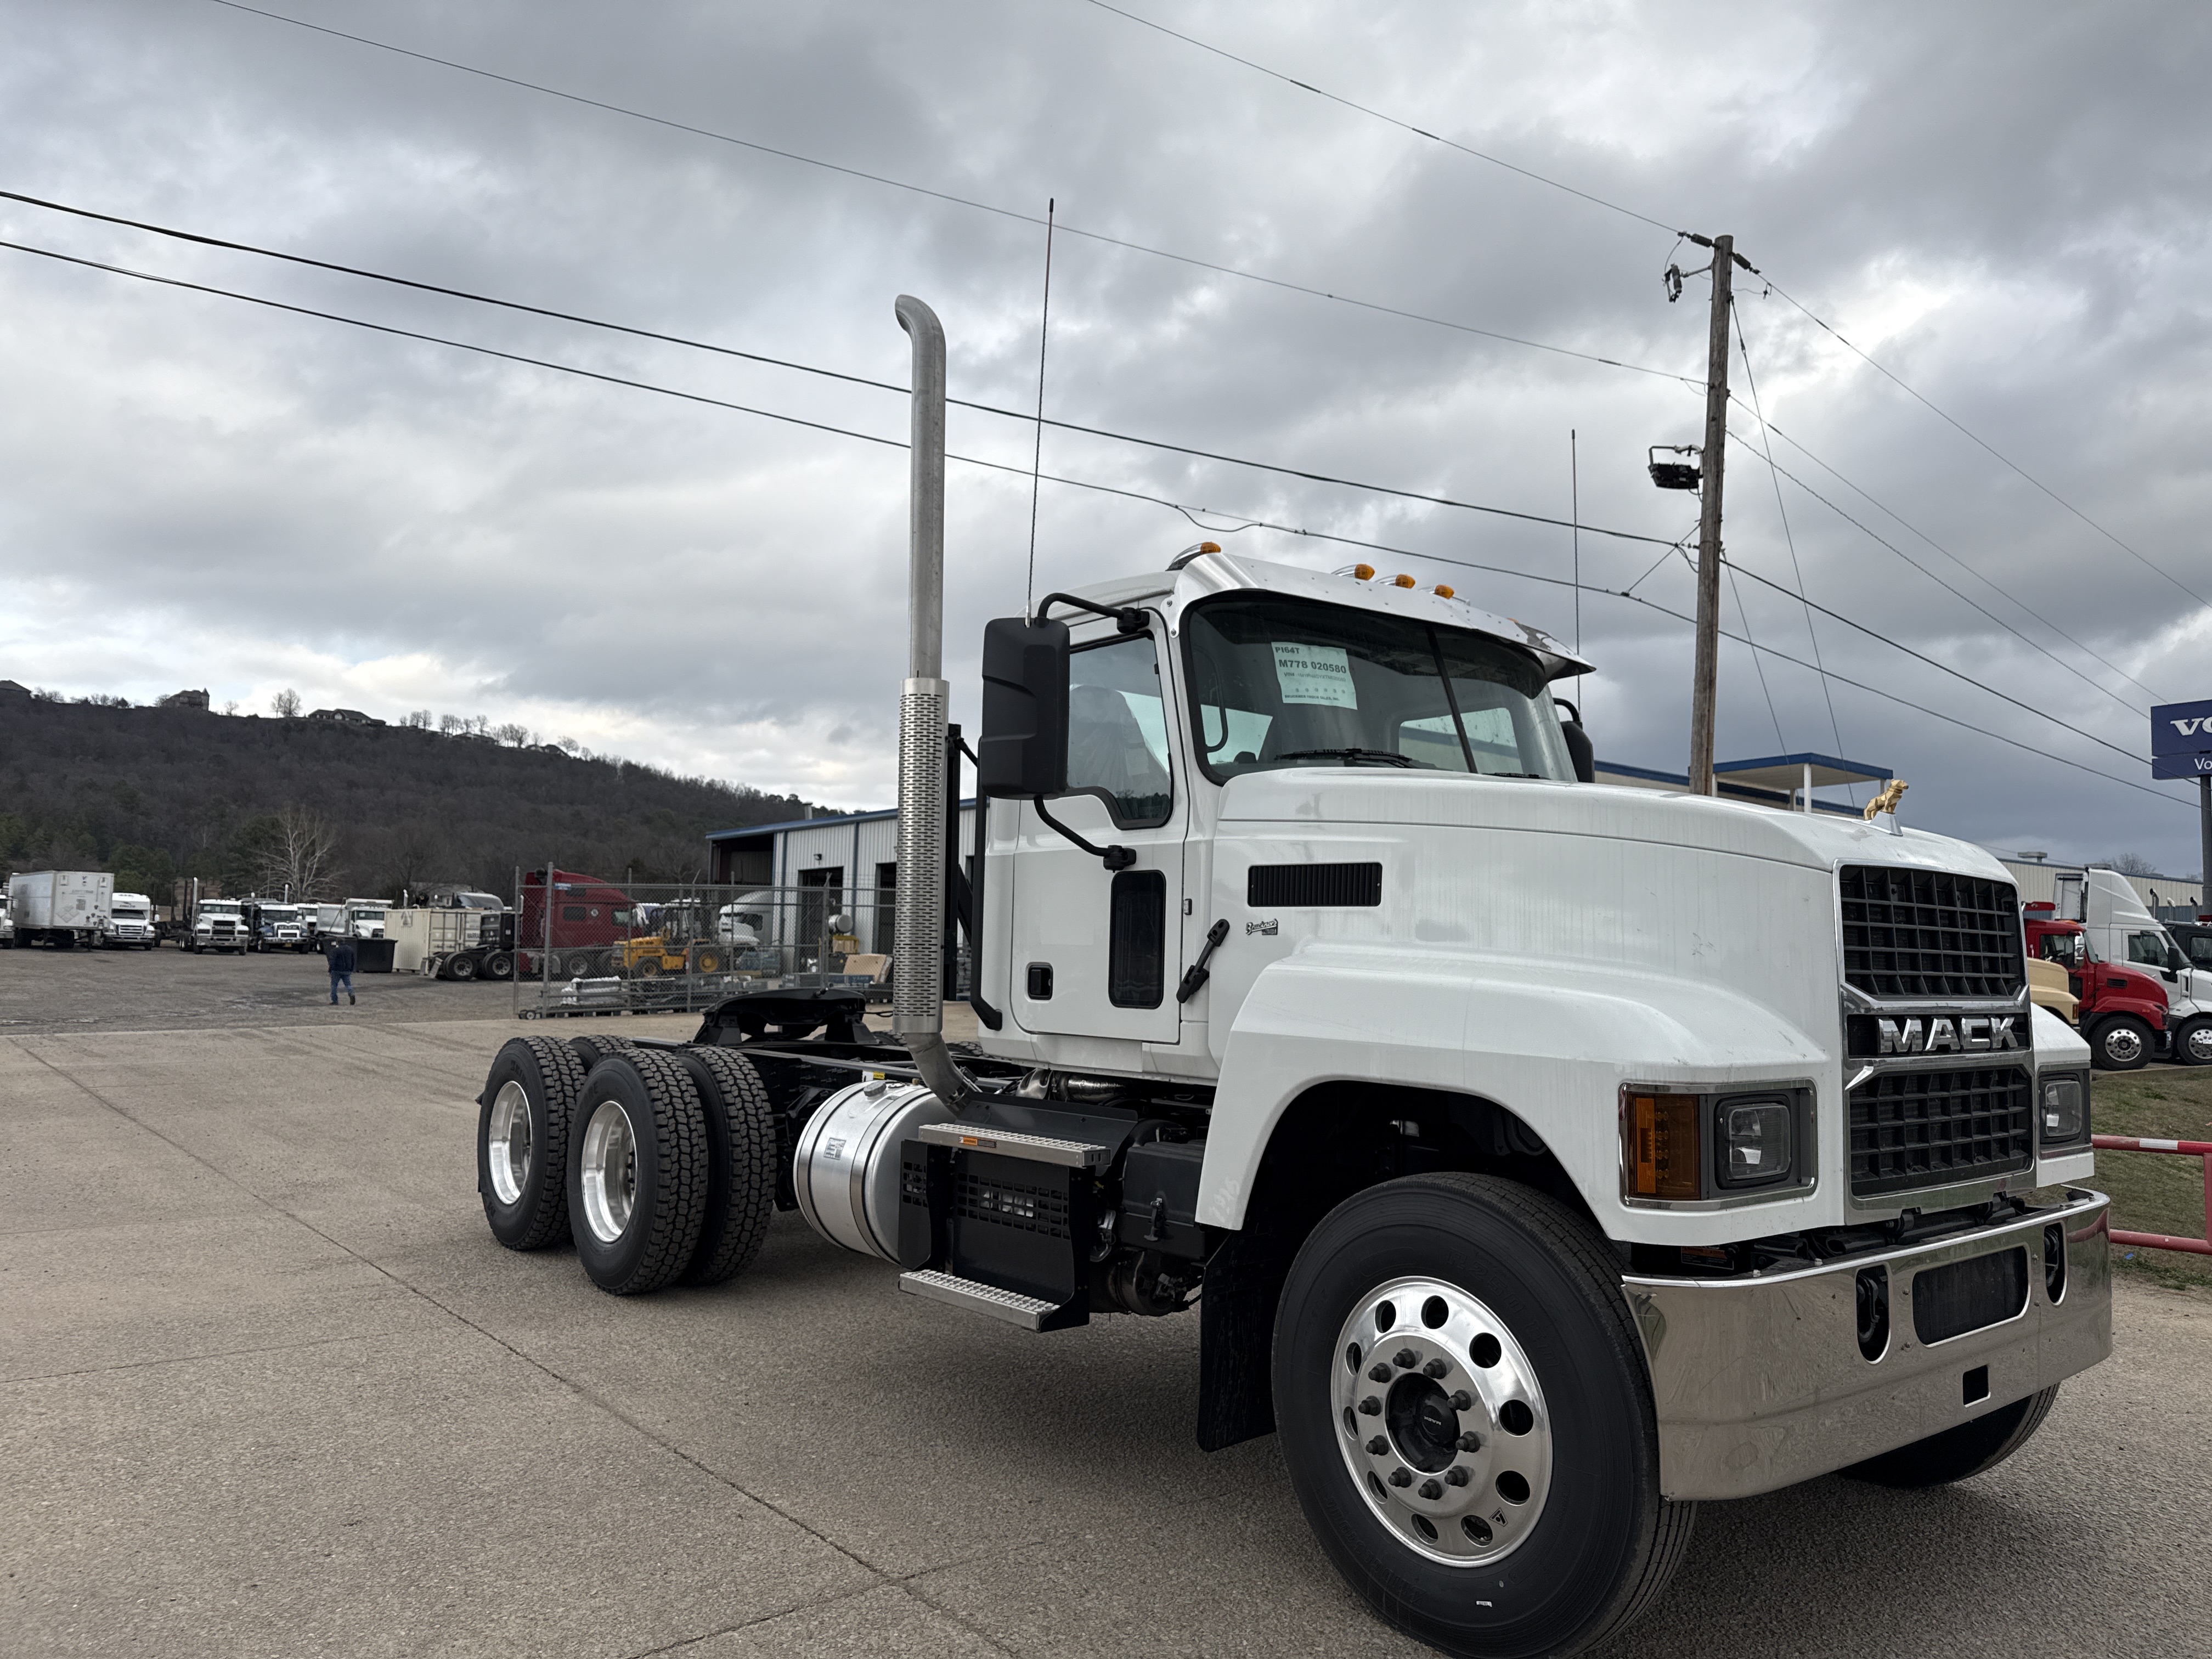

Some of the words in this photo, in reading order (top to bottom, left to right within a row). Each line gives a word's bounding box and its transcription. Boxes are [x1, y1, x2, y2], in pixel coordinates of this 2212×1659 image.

[1279, 659, 1308, 669] M778
[1311, 662, 1347, 674] 020580
[1878, 1017, 2018, 1053] MACK
